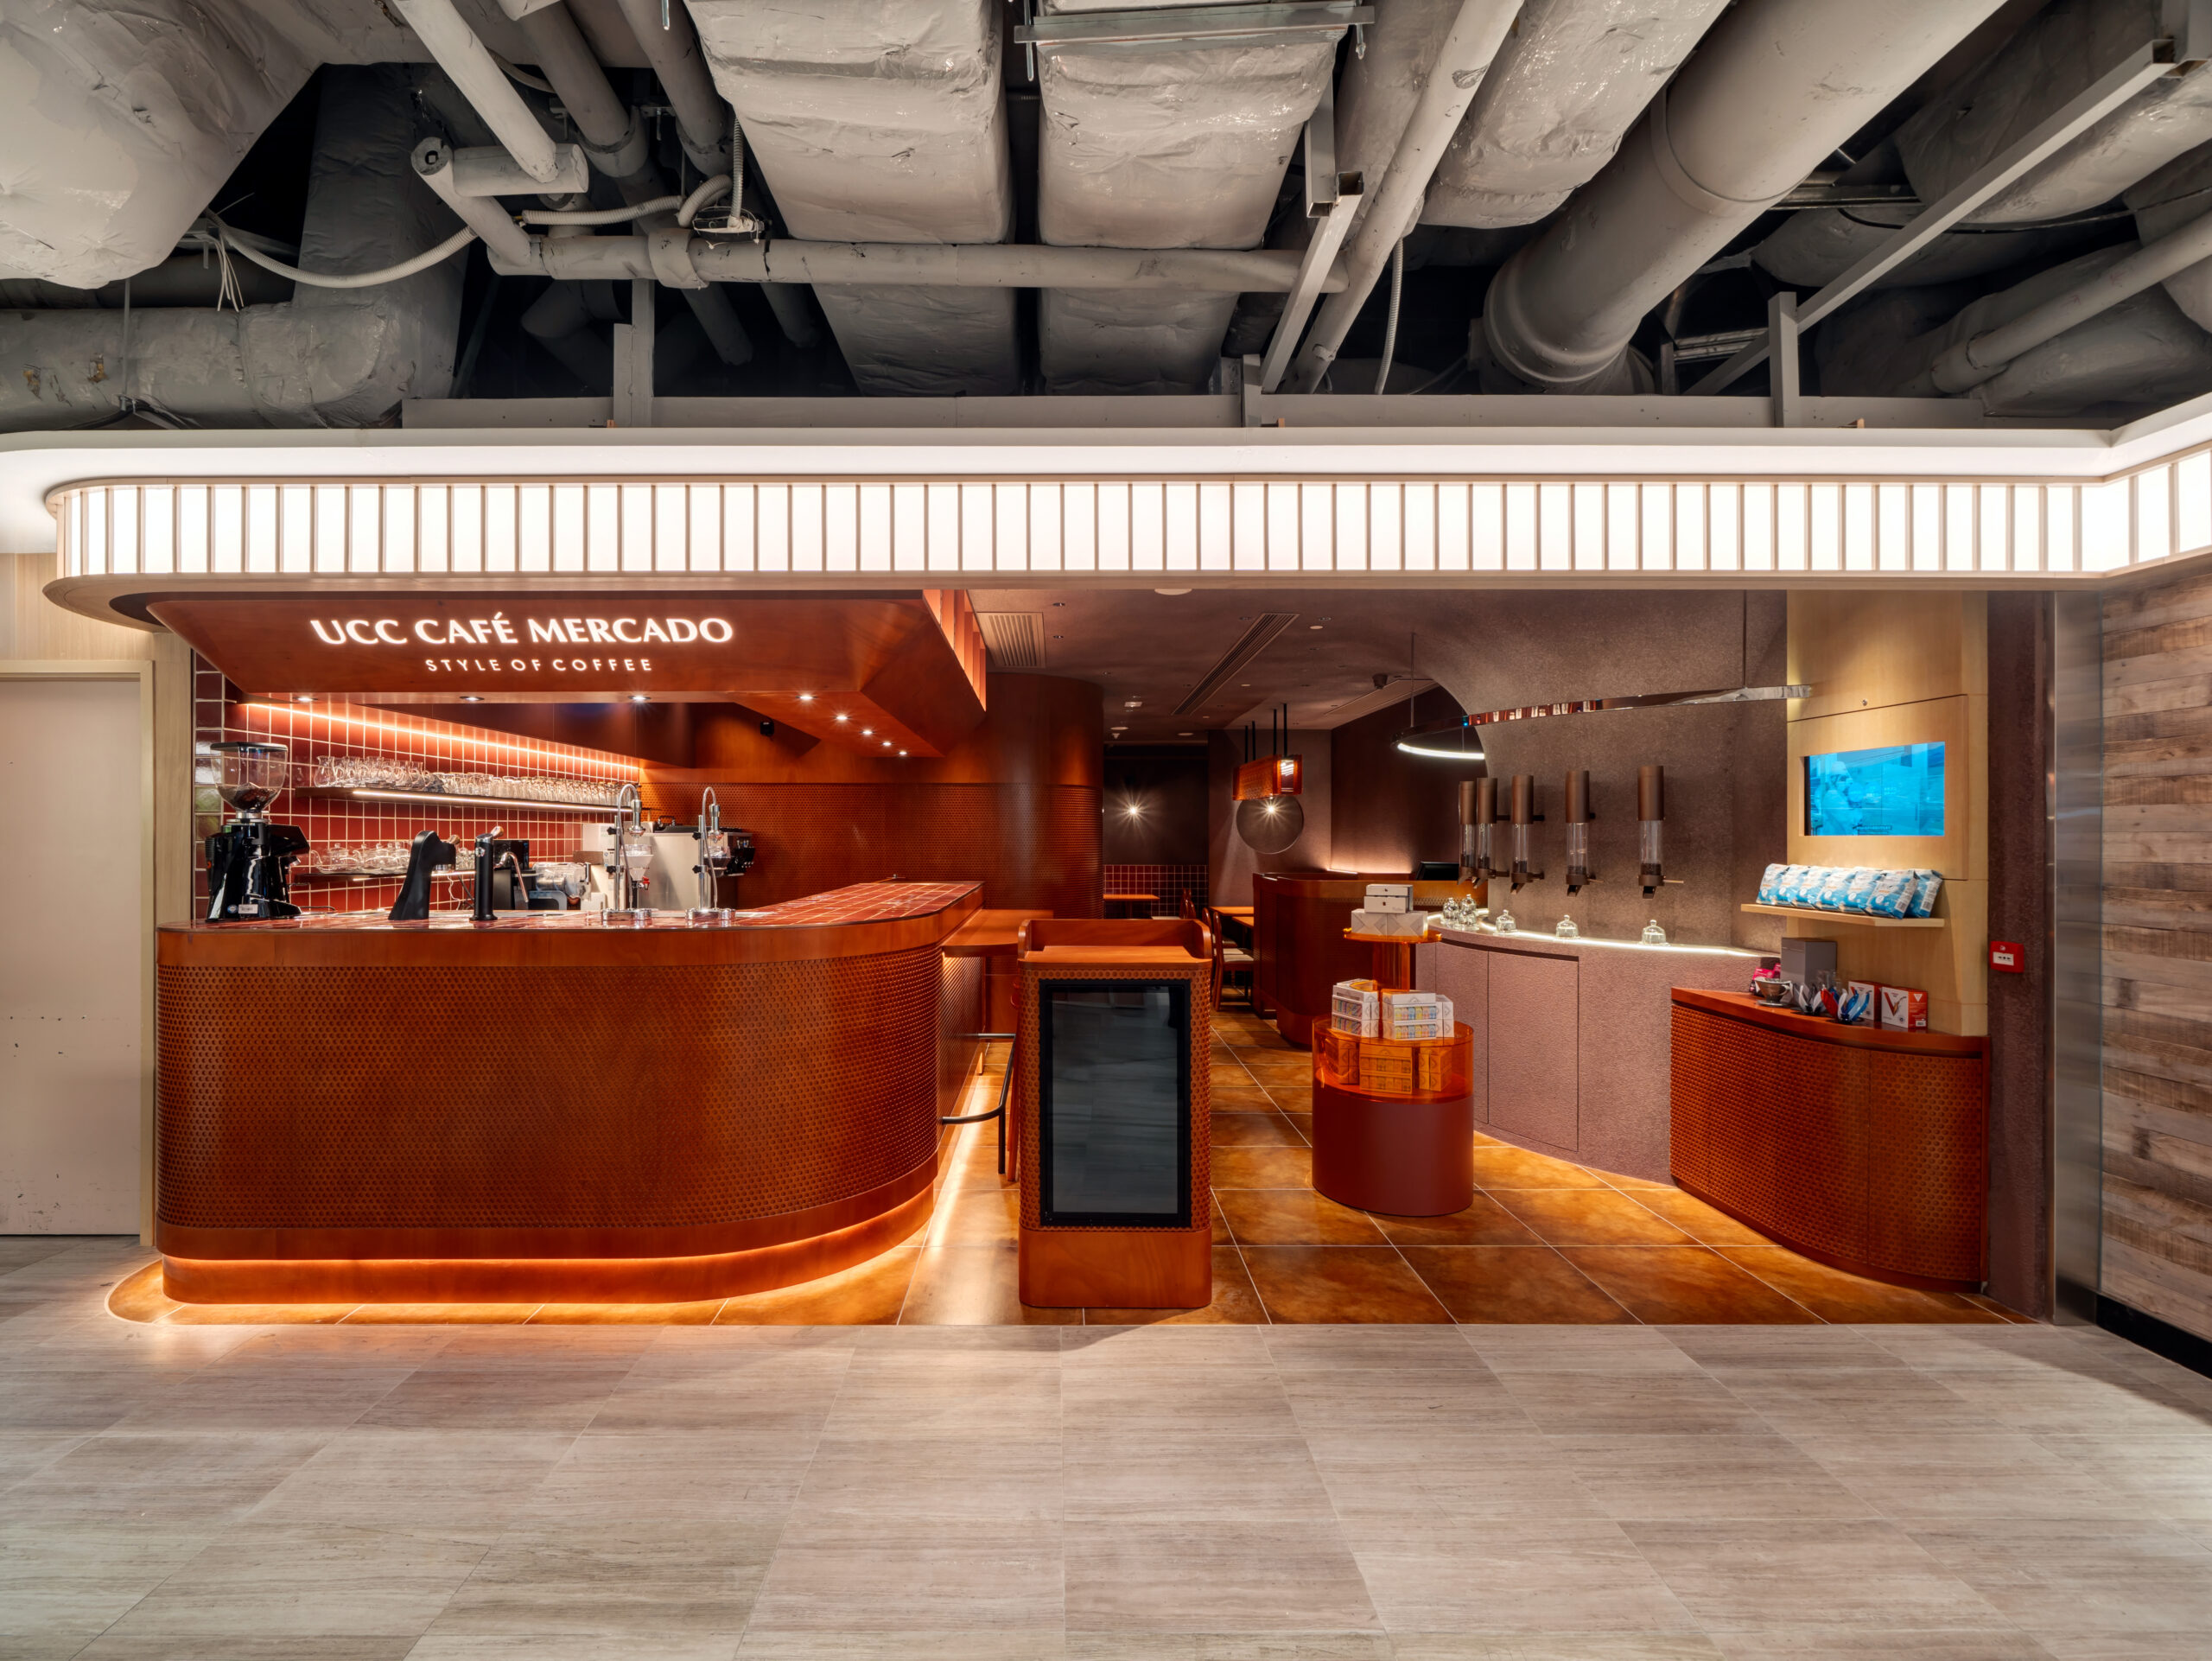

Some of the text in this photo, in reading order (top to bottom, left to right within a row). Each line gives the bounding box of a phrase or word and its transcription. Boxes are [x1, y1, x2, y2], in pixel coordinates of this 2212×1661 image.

[309, 611, 734, 646] UCC CAFÉ MERCADO
[425, 659, 652, 671] STYLE OF COFFEE
